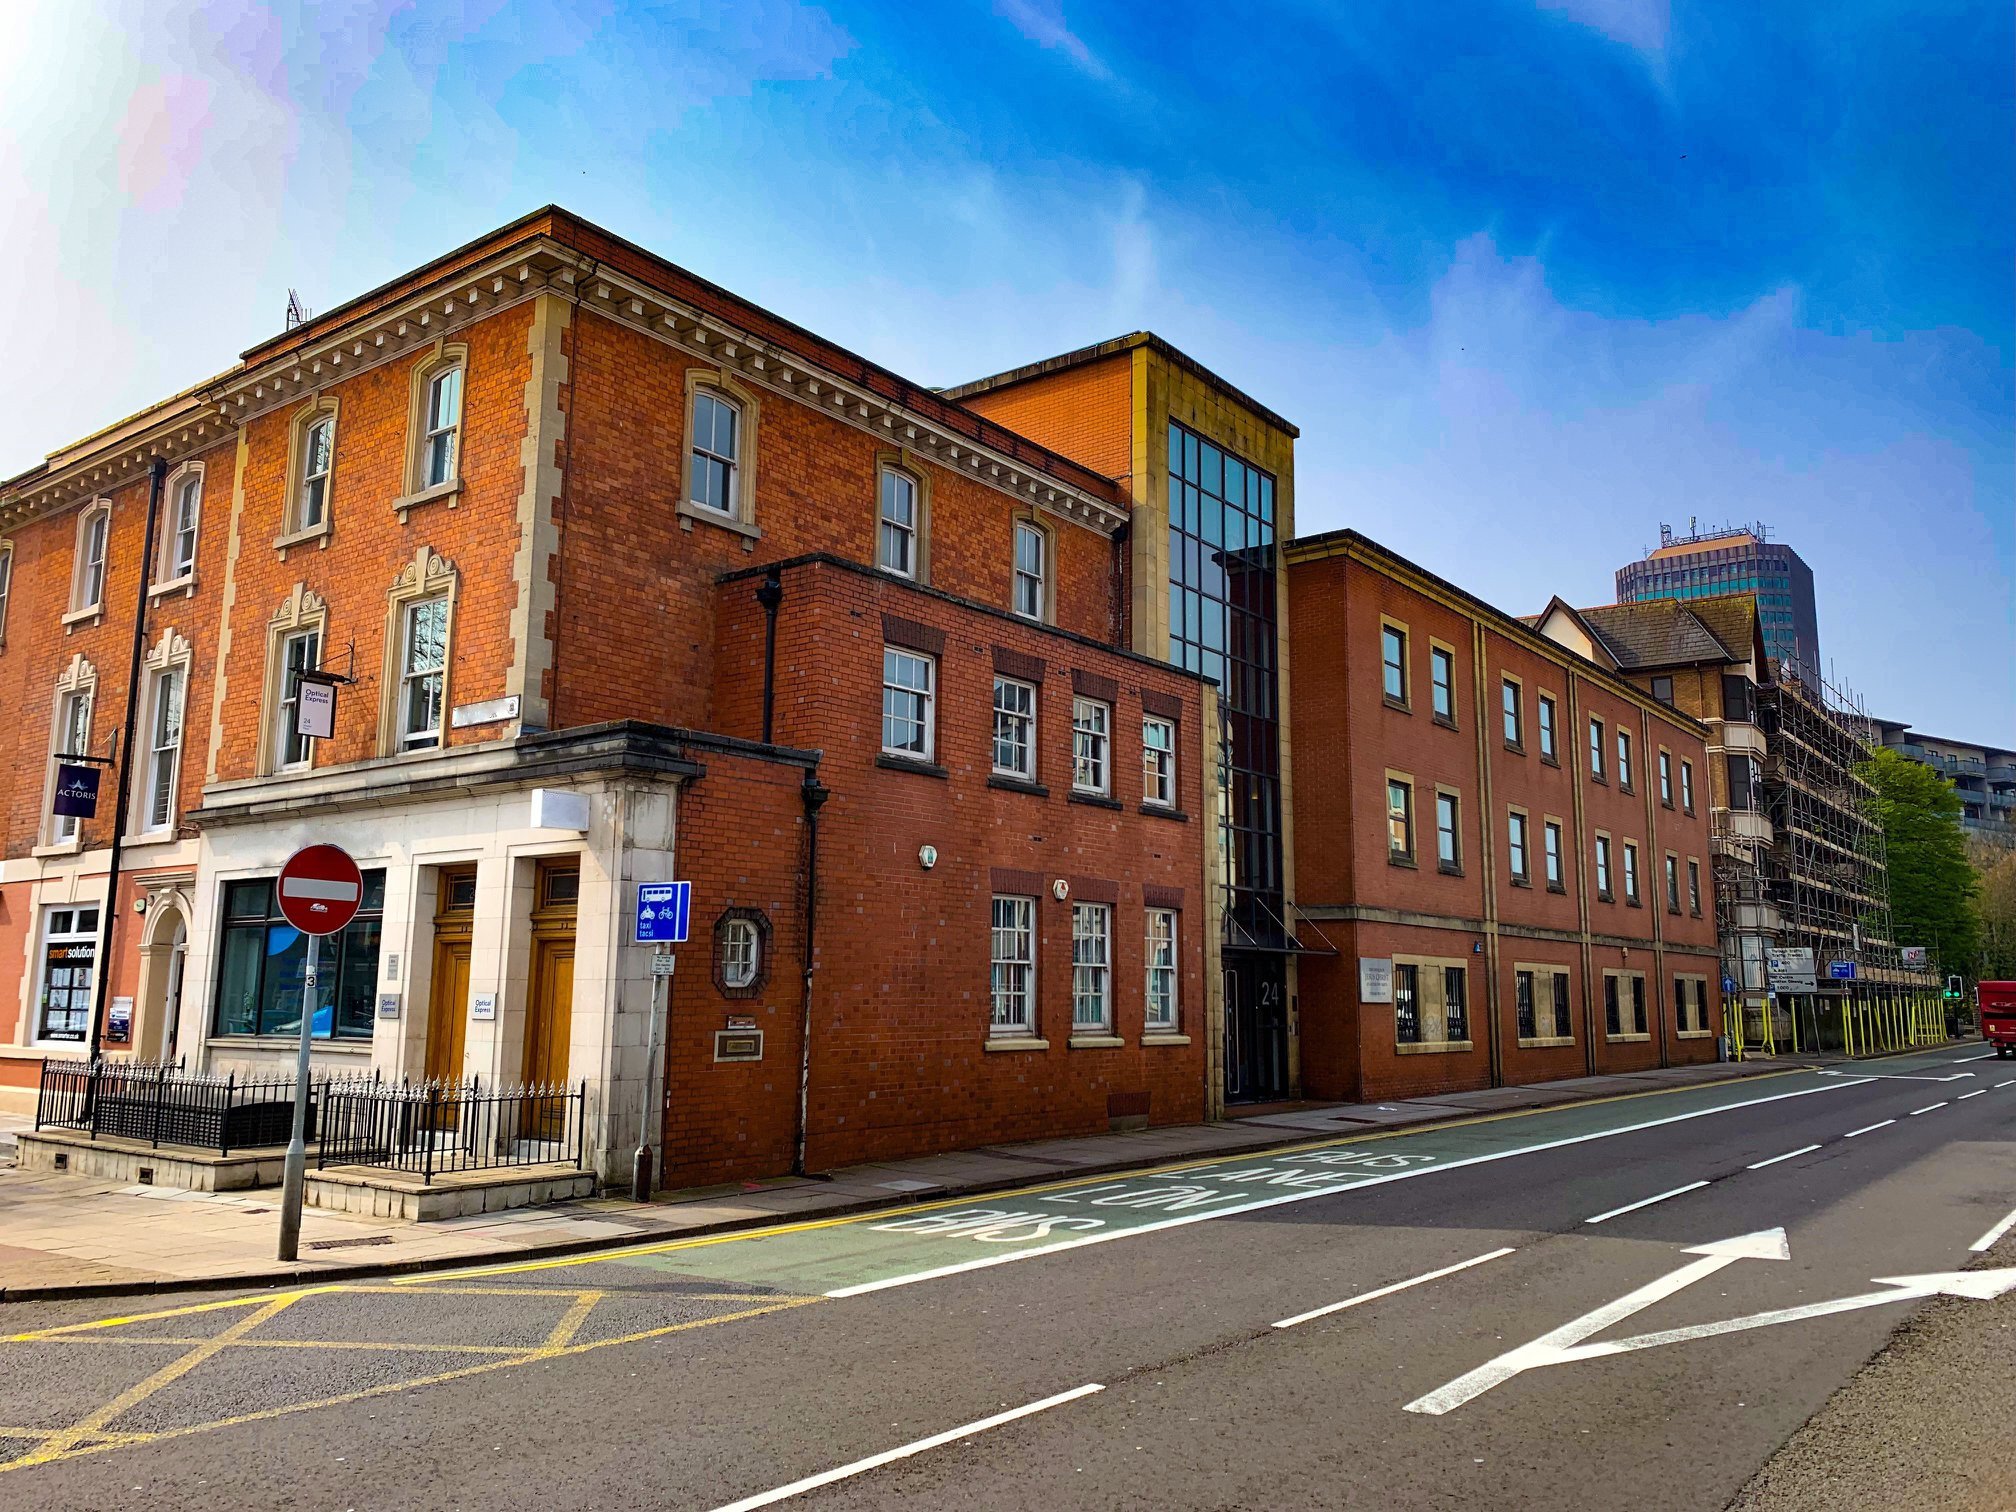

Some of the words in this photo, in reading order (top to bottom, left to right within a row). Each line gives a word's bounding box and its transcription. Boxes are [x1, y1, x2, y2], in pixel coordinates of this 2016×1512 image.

[305, 689, 329, 698] Optical
[304, 695, 329, 704] Express
[57, 789, 96, 800] ACTORIS
[639, 921, 652, 929] taxi
[639, 930, 654, 938] tacsi
[307, 976, 315, 987] 3
[1261, 981, 1279, 1006] 24
[381, 999, 396, 1007] Optical
[475, 999, 491, 1007] Optical
[474, 1006, 491, 1014] Express
[1272, 1151, 1436, 1167] BUS
[1148, 1165, 1384, 1188] LANE
[868, 1209, 1106, 1242] BWS
